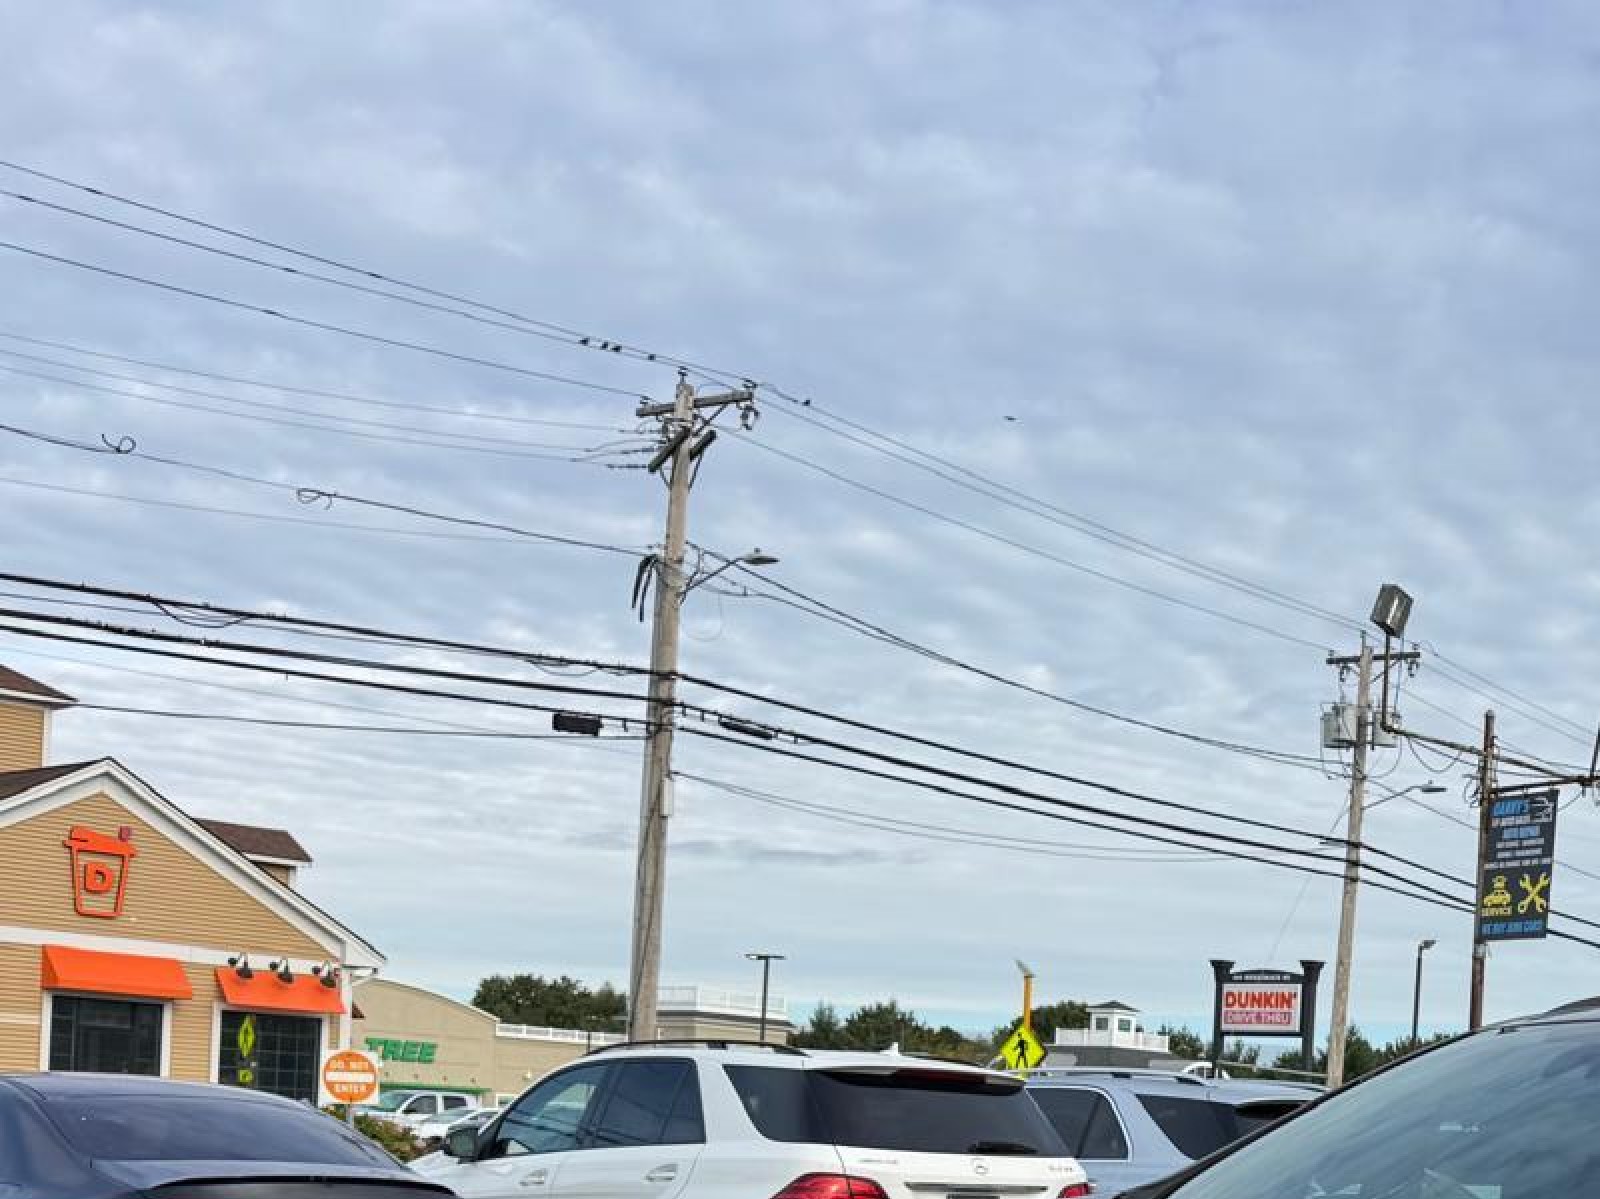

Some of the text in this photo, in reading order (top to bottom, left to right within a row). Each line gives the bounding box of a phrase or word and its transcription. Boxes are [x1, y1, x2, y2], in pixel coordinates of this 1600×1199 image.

[84, 862, 115, 893] D
[1225, 991, 1297, 1009] DUNKIN'
[1227, 1012, 1289, 1024] DRIVE THRU
[365, 1037, 438, 1063] TREE
[349, 1061, 369, 1071] NOT
[334, 1083, 367, 1094] ENTER
